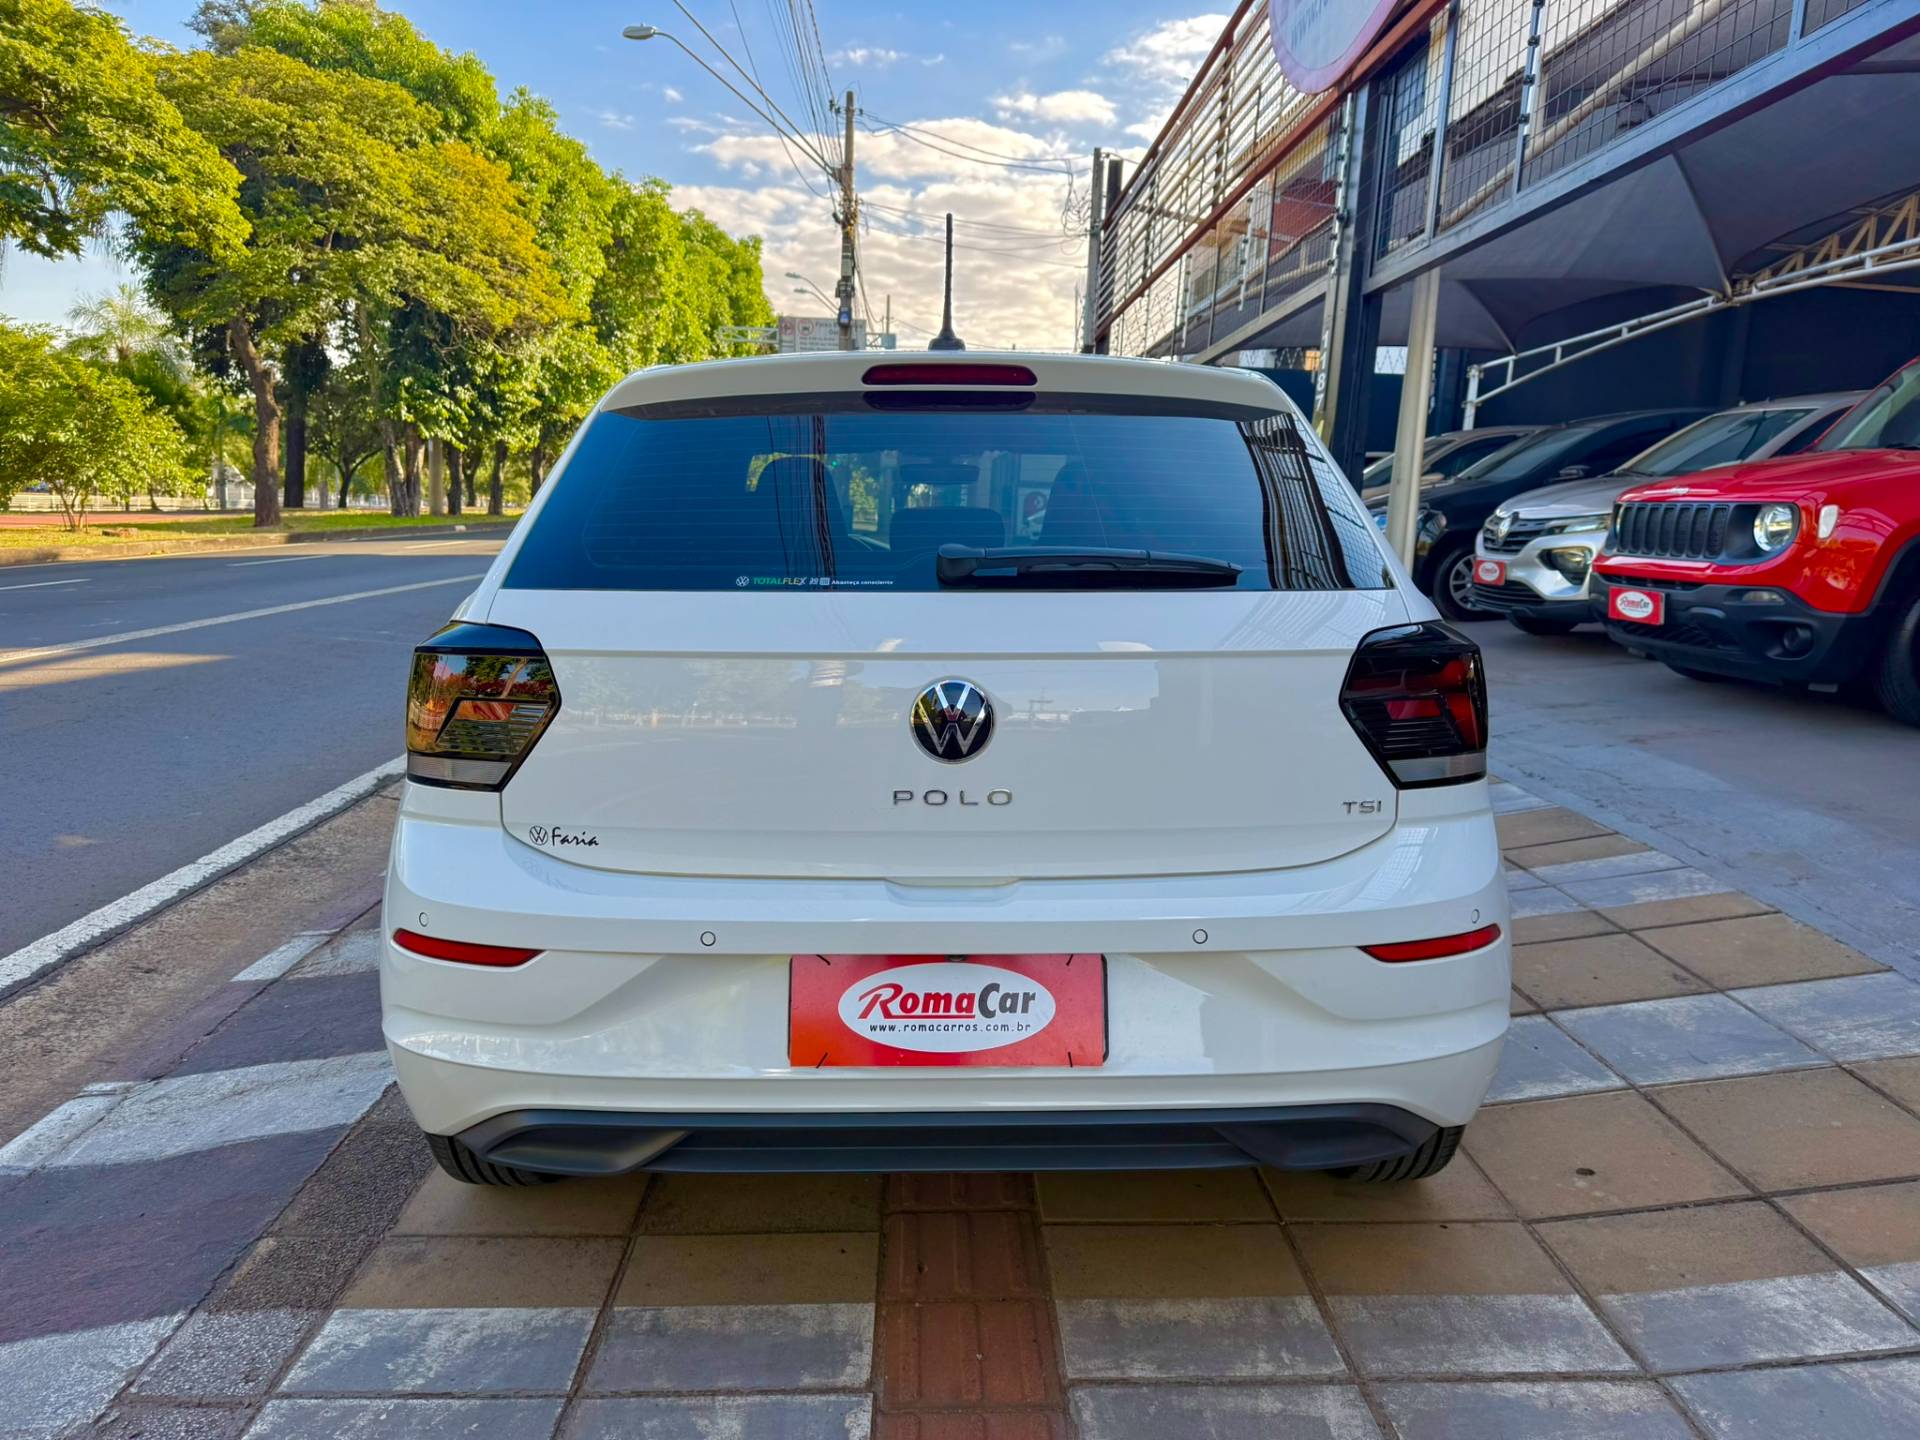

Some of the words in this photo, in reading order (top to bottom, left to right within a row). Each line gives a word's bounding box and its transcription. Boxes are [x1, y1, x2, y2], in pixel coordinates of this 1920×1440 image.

[893, 789, 1013, 806] POLO
[1342, 800, 1382, 814] TSI
[551, 826, 599, 846] Faria
[857, 982, 1036, 1020] RomaCar
[869, 1021, 1031, 1033] www.romacarros.com.br
